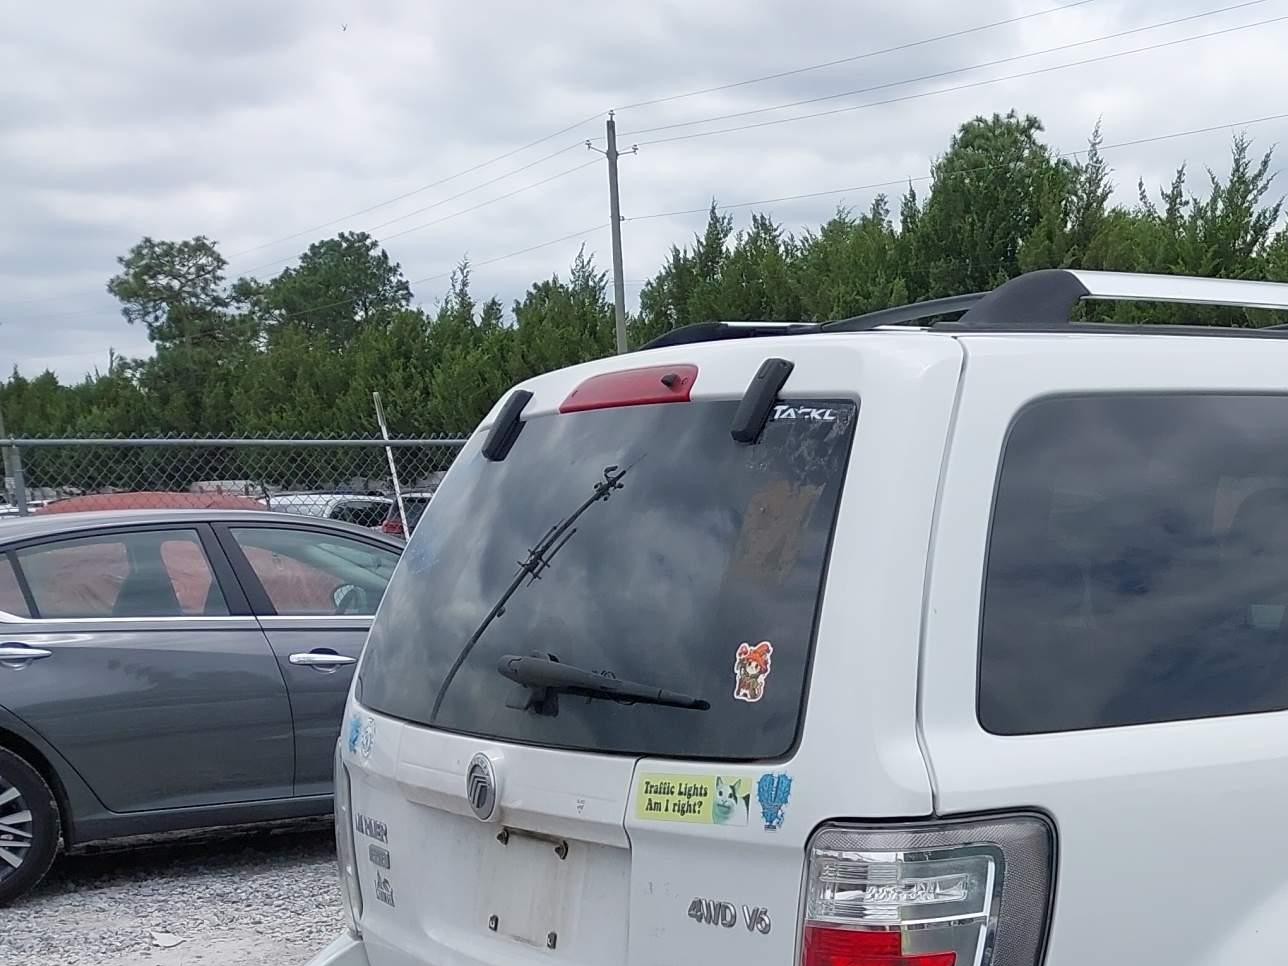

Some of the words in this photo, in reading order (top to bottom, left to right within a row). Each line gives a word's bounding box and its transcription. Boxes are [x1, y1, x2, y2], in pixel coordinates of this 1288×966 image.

[644, 781, 676, 796] Traffic
[677, 783, 708, 799] Lights
[645, 798, 662, 812] Am
[664, 799, 669, 812] I
[672, 800, 703, 816] right?
[687, 897, 737, 928] 4WD
[742, 904, 771, 934] V6
